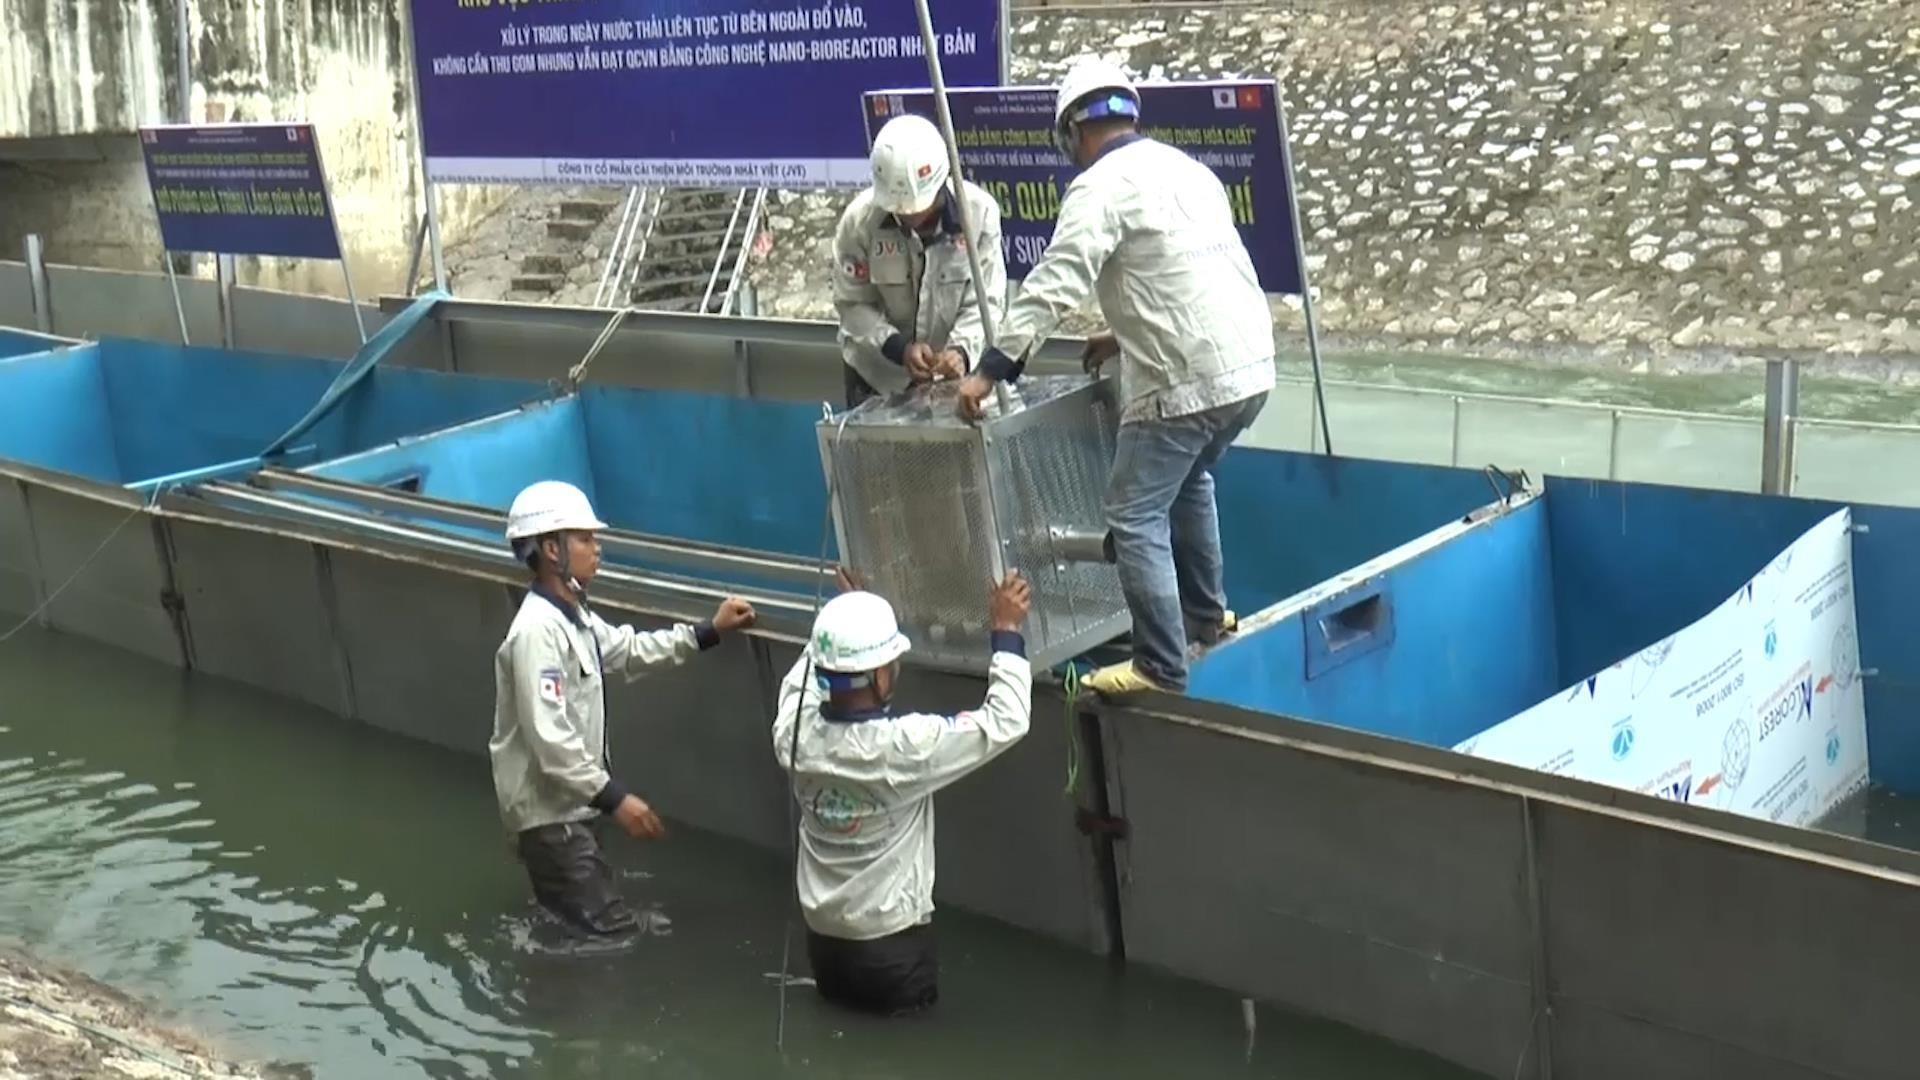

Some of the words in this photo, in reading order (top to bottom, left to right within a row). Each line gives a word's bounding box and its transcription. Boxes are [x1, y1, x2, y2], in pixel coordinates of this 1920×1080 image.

[517, 24, 530, 45] LÝ
[532, 25, 568, 44] TRONG
[570, 20, 600, 42] NGÀY
[602, 18, 633, 41] NƯỚC
[635, 13, 662, 39] THẢI
[664, 14, 692, 37] LIÊN
[694, 16, 719, 39] TỤC
[721, 11, 738, 34] TỪ
[741, 9, 767, 33] BÊN
[769, 6, 809, 31] NGOÀI
[834, 3, 867, 29] VÀO,
[432, 54, 466, 75] KHÔNG
[489, 55, 511, 73] THU
[512, 54, 536, 73] GOM
[537, 51, 574, 71] NHƯNG
[601, 50, 623, 72] ĐẠT
[625, 47, 658, 69] QCVN
[660, 40, 693, 67] BẰNG
[695, 42, 729, 65] CÔNG
[731, 40, 766, 67] NGHỆ
[768, 36, 898, 62] NANO-BIOREACTOR
[944, 26, 977, 55] BẢN
[1016, 174, 1061, 221] QUÁ
[1224, 175, 1254, 225] HÍ
[1759, 673, 1812, 741] ALCOREST
